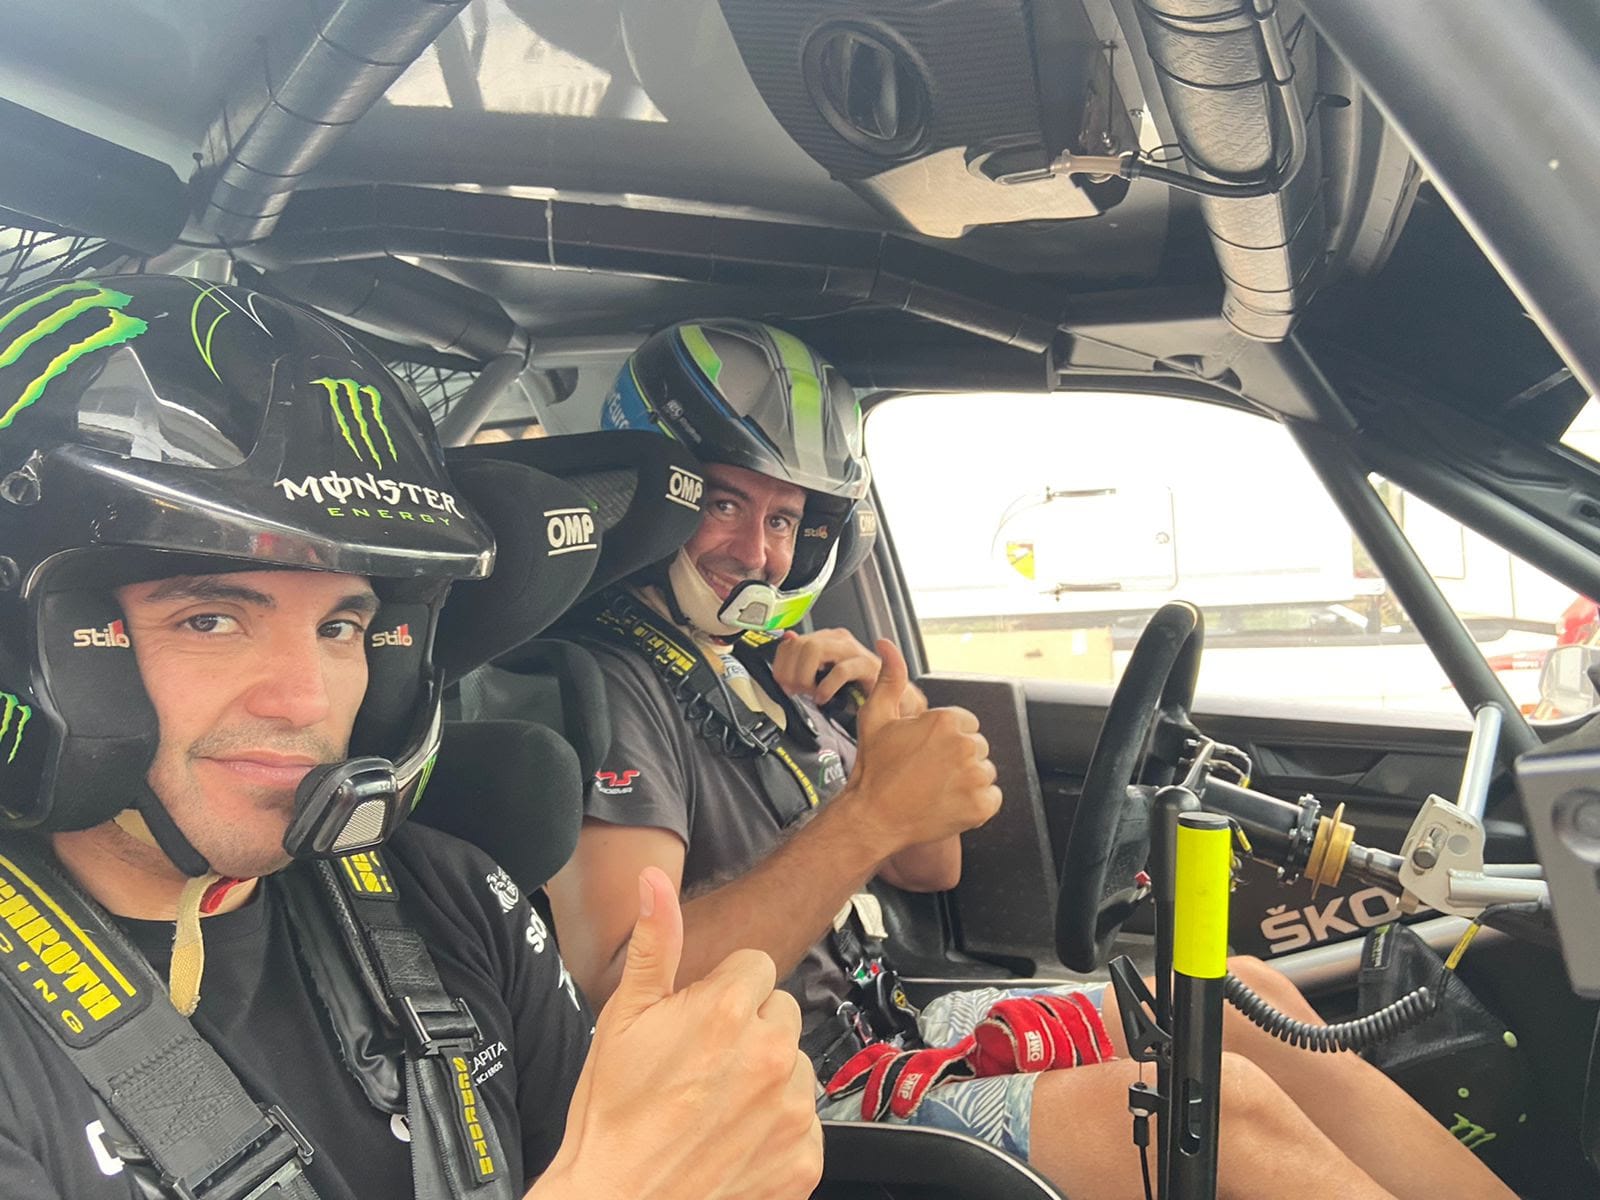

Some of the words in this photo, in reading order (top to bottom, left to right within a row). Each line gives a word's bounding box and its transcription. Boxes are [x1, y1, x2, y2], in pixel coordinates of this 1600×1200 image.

[274, 471, 465, 519] MONSTER
[668, 471, 703, 504] OMP
[327, 507, 451, 527] ENERGY
[547, 514, 595, 549] OMP
[1260, 886, 1403, 954] ŠKO
[452, 1056, 494, 1176] SCHROTH
